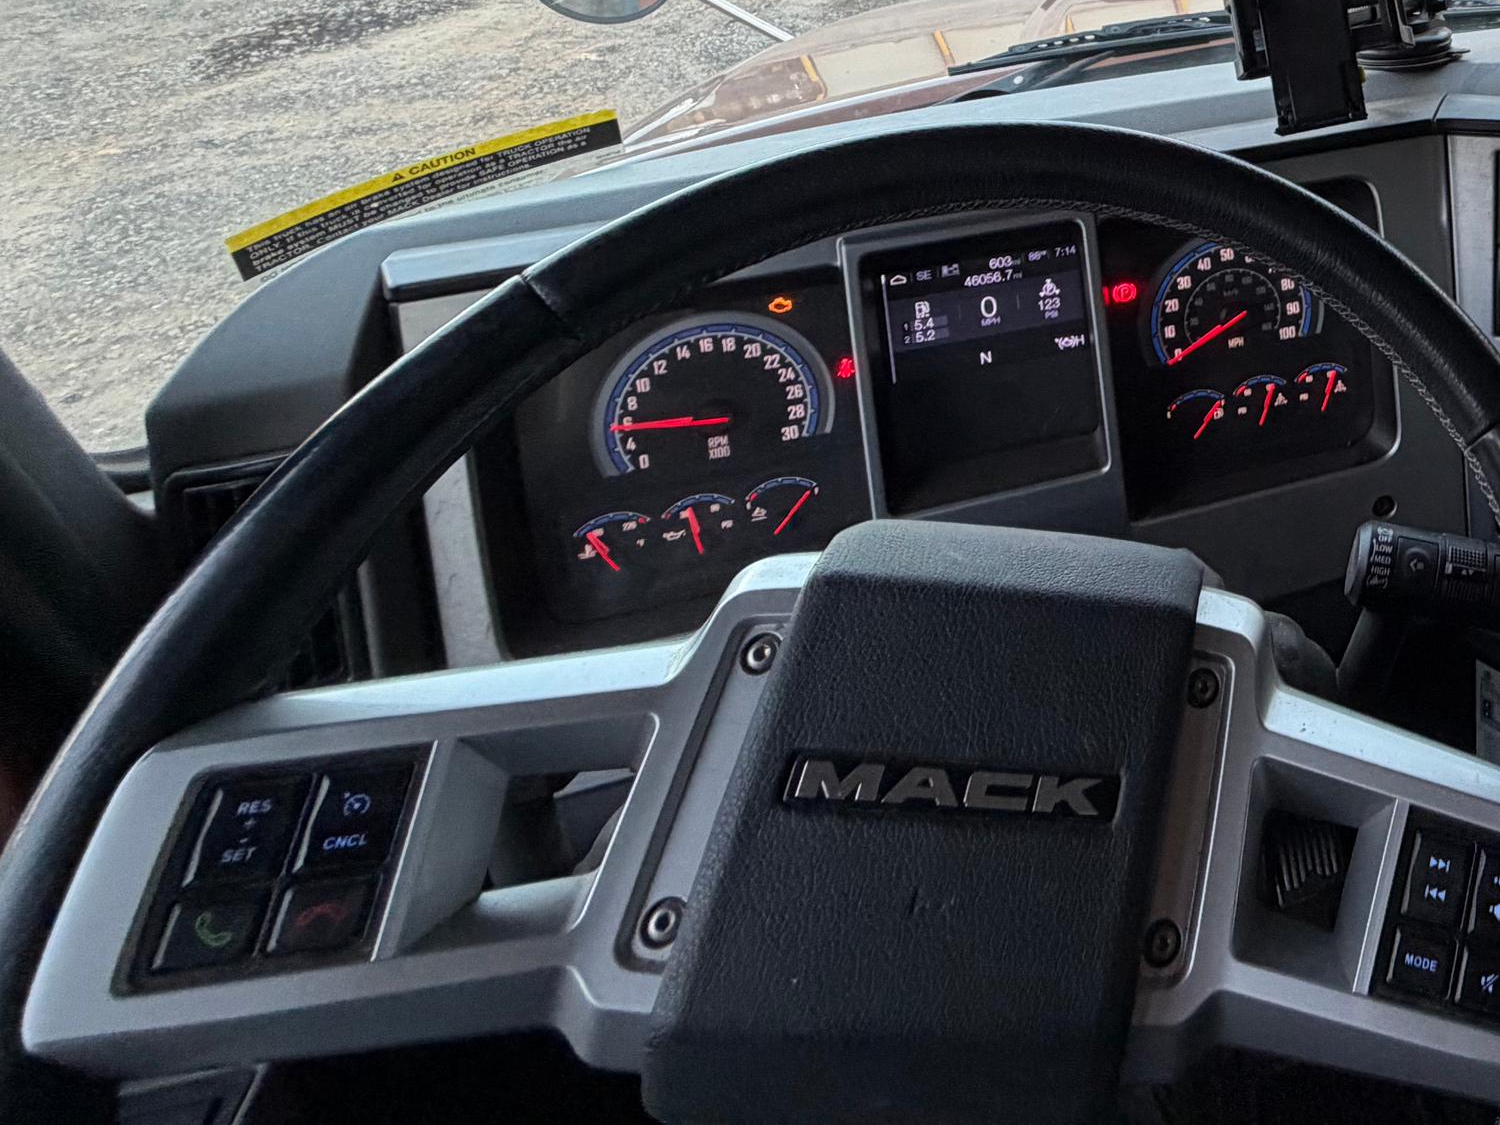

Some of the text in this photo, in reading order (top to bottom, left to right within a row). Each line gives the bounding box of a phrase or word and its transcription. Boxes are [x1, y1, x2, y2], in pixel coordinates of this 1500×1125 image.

[393, 177, 431, 193] system
[432, 161, 479, 179] designed
[480, 155, 494, 165] for
[498, 144, 533, 158] TRUCK
[534, 127, 592, 146] OPERATION
[409, 147, 476, 175] CAUTION
[363, 187, 417, 211] cnverted
[434, 166, 482, 185] operation
[508, 143, 557, 161] TRACTOR
[252, 248, 285, 266] brake
[286, 230, 327, 251] system
[328, 215, 360, 232] MUST
[380, 192, 424, 212] changed
[440, 174, 478, 193] provide
[479, 163, 507, 179] SAFE
[507, 146, 565, 167] OPERATION
[316, 223, 361, 245] Contact
[361, 213, 385, 227] your
[386, 199, 421, 216] MACK
[422, 187, 456, 203] Dealer
[1054, 245, 1076, 257] 7:14
[1219, 248, 1235, 263] 50
[989, 255, 1012, 269] 603
[1197, 258, 1212, 272] 40
[1177, 275, 1192, 291] 30
[980, 296, 997, 317] 0
[1038, 297, 1061, 311] 123
[1164, 299, 1179, 313] 20
[1286, 301, 1300, 315] 90
[914, 319, 935, 331] 5.4
[1164, 325, 1176, 339] 10
[914, 330, 936, 343] 5.2
[1279, 327, 1296, 341] 100
[700, 337, 714, 353] 16
[722, 337, 736, 352] 18
[743, 342, 761, 359] 20
[1228, 337, 1245, 349] MPH
[676, 345, 691, 361] 14
[979, 351, 992, 365] N
[653, 359, 668, 376] 12
[763, 354, 781, 370] 22
[778, 367, 796, 382] 24
[635, 377, 651, 393] 10
[786, 385, 804, 401] 26
[626, 396, 638, 411] 8
[787, 404, 806, 421] 28
[781, 425, 800, 442] 30
[626, 437, 636, 451] 4
[707, 435, 729, 448] RPM
[638, 454, 650, 469] 0
[1375, 543, 1394, 555] LOW
[1374, 554, 1392, 565] MED
[1371, 565, 1392, 577] HIGH
[794, 758, 1103, 816] MACK
[236, 797, 273, 817] RES
[321, 832, 370, 852] CNCL
[220, 846, 257, 864] SET
[1404, 952, 1439, 973] MODE
